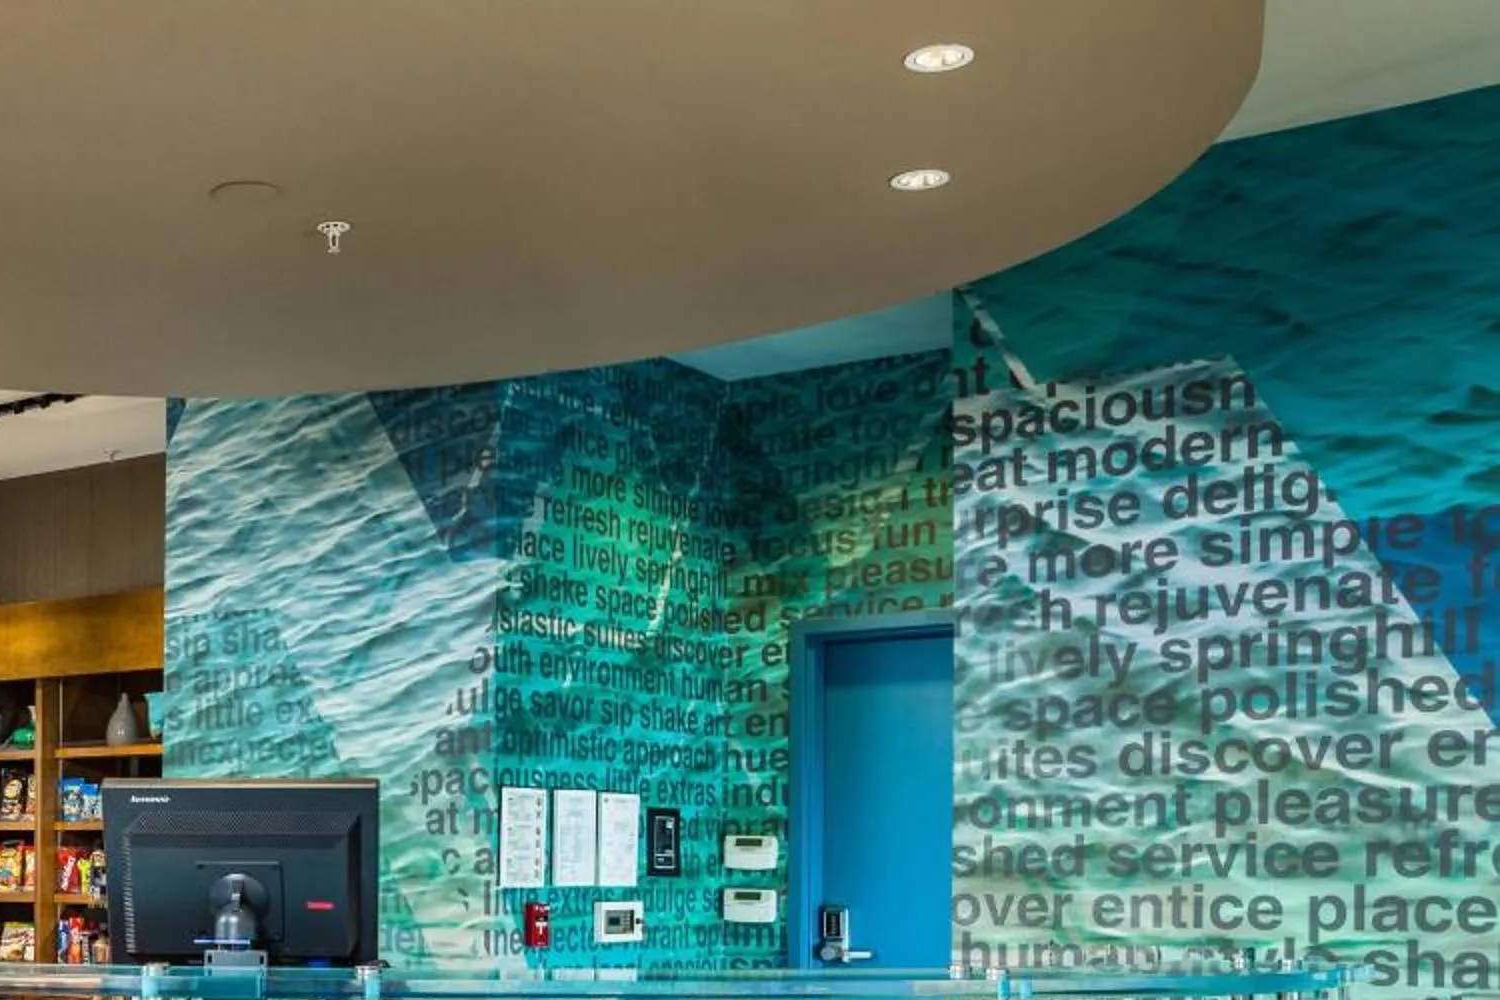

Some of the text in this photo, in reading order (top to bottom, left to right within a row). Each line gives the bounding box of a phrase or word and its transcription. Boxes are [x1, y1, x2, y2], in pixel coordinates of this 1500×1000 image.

[1047, 419, 1283, 484] modern
[1162, 463, 1338, 520] delig
[572, 533, 628, 585] lively
[1029, 536, 1179, 584] more
[1161, 606, 1479, 684] springhill
[446, 678, 522, 722] ulge
[601, 695, 633, 728] sip
[1004, 687, 1177, 742] space
[1201, 660, 1495, 734] polished
[1119, 728, 1404, 778] discover
[953, 828, 1500, 879] shed service refr
[954, 883, 1498, 944] over entice place
[1363, 938, 1500, 990] sha
